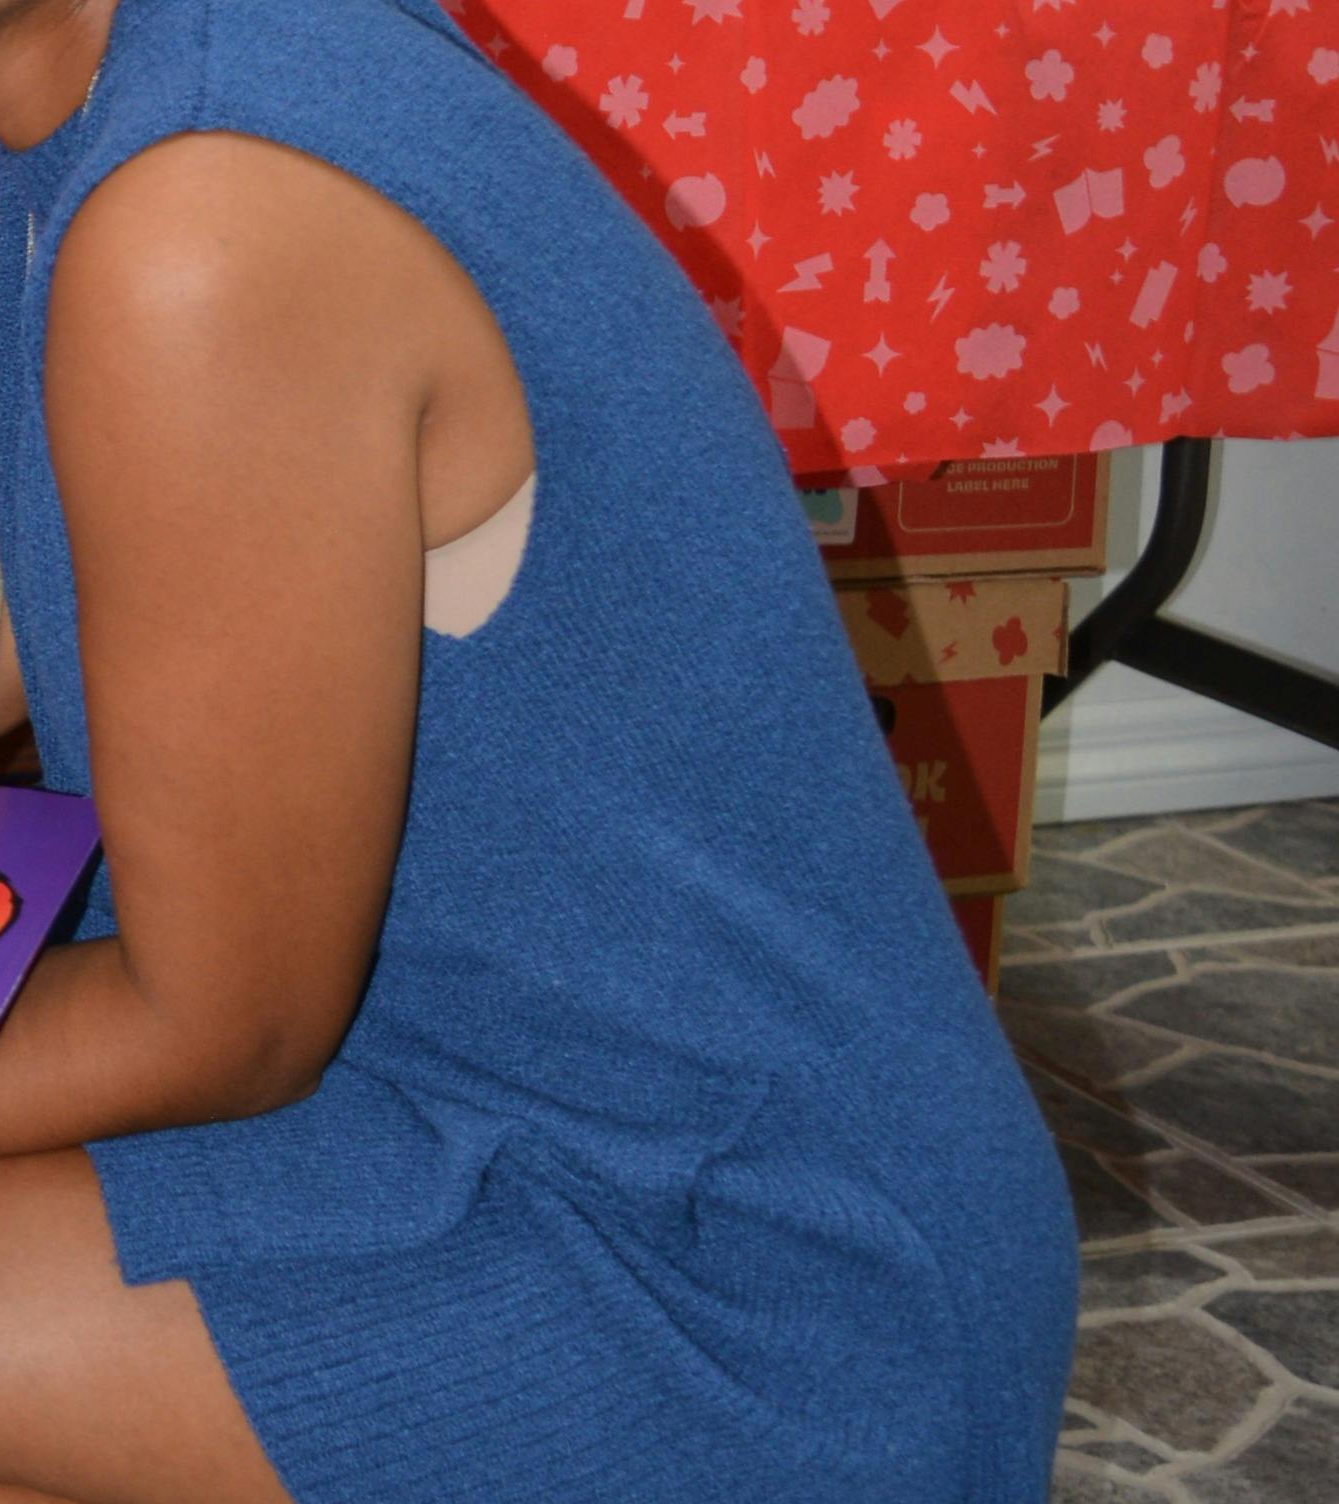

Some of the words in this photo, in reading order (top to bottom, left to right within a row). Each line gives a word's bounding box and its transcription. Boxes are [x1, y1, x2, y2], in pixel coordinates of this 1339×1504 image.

[968, 458, 1059, 474] PRODUCTION
[947, 480, 987, 493] LABEL
[992, 478, 1029, 491] HERE
